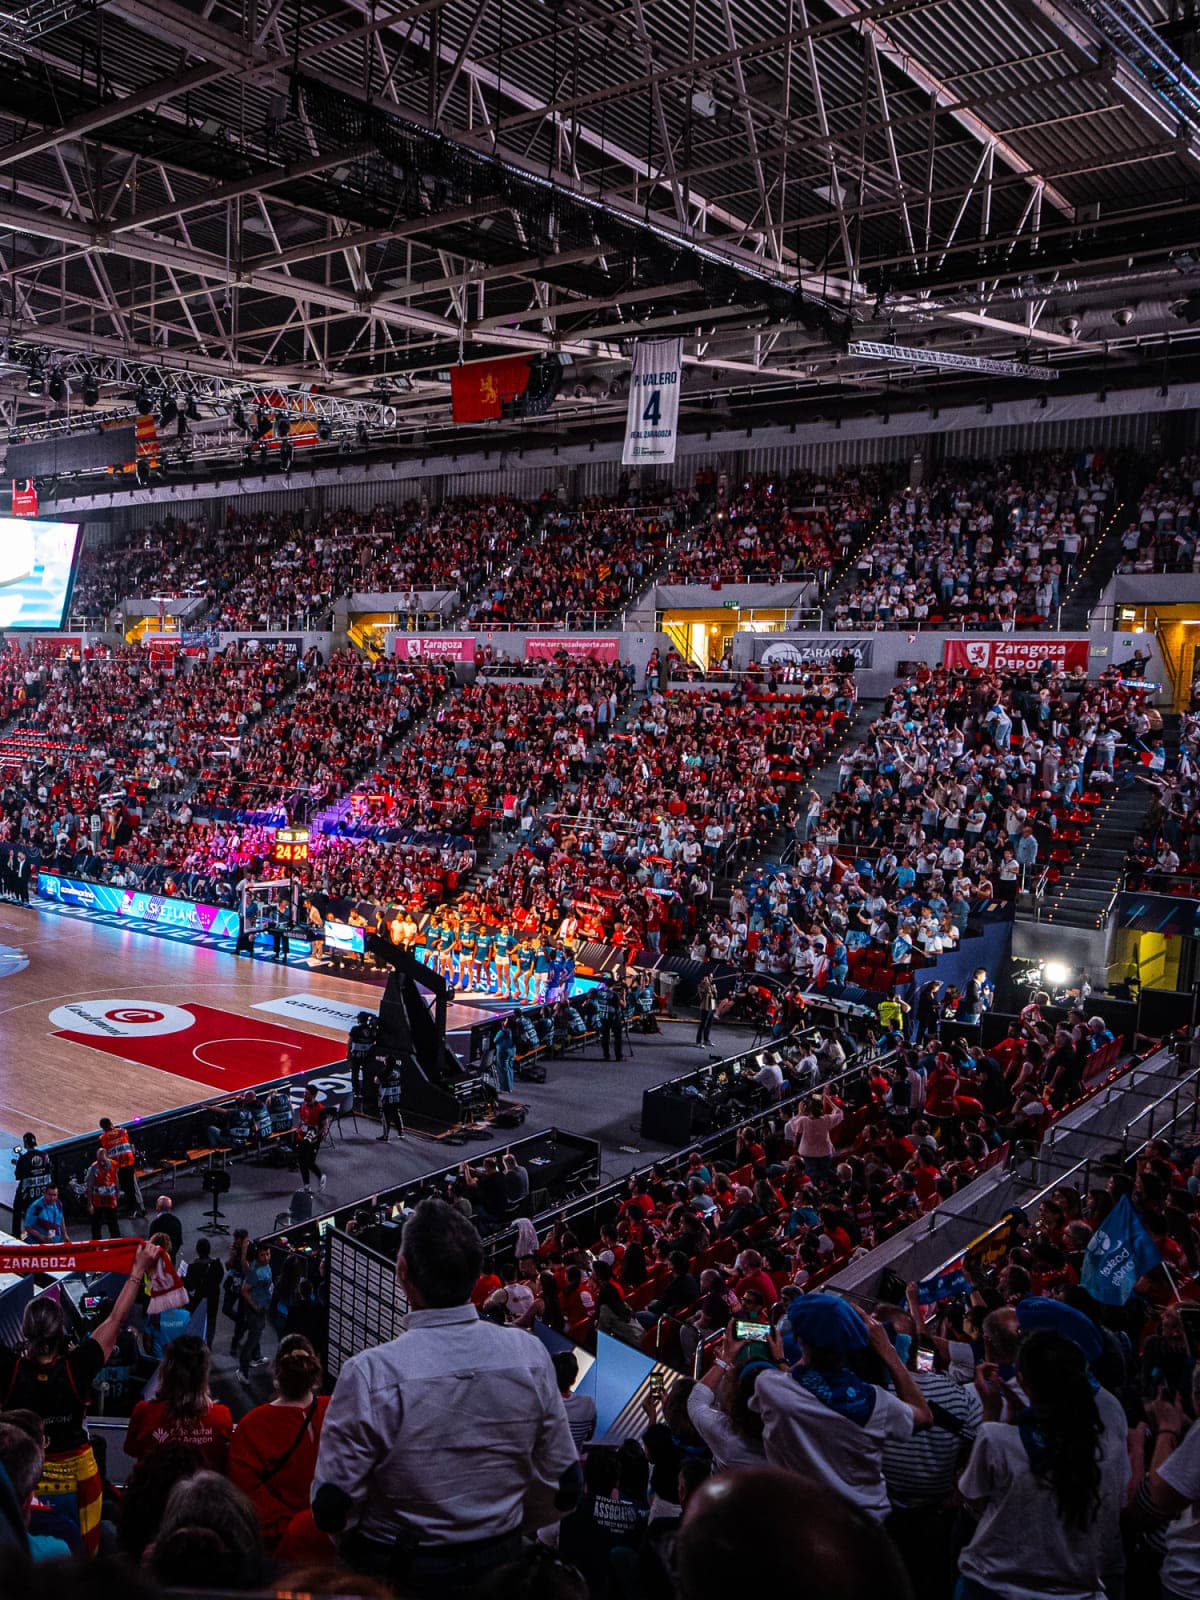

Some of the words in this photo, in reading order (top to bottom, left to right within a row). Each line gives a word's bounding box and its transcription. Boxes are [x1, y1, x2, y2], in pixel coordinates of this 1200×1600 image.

[643, 371, 677, 386] VALERO
[643, 390, 661, 426] 4
[423, 639, 462, 651] Zaragoza
[995, 642, 1066, 656] Zaragoza
[276, 844, 291, 860] 24
[294, 844, 307, 860] 24
[3, 1256, 76, 1269] ZARAGOZA
